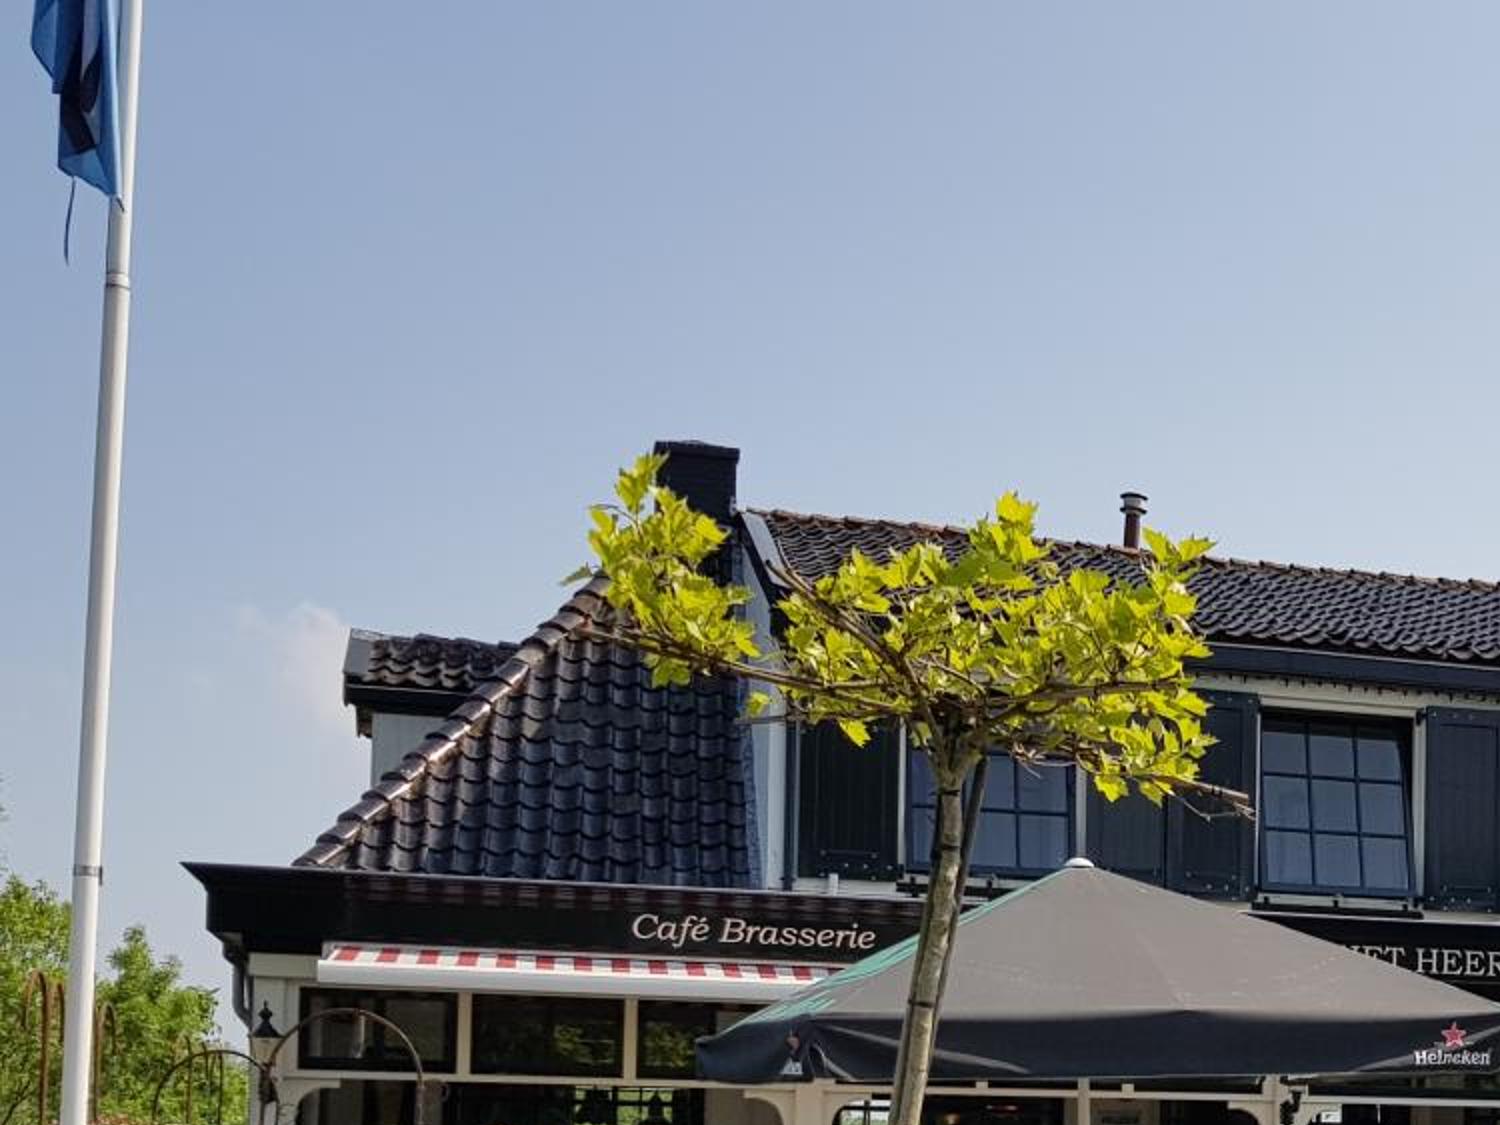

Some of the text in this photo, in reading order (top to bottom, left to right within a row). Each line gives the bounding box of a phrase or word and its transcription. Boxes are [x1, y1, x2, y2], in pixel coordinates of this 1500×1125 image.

[631, 913, 876, 949] Café Brasserie
[1414, 1048, 1491, 1065] Heineken
